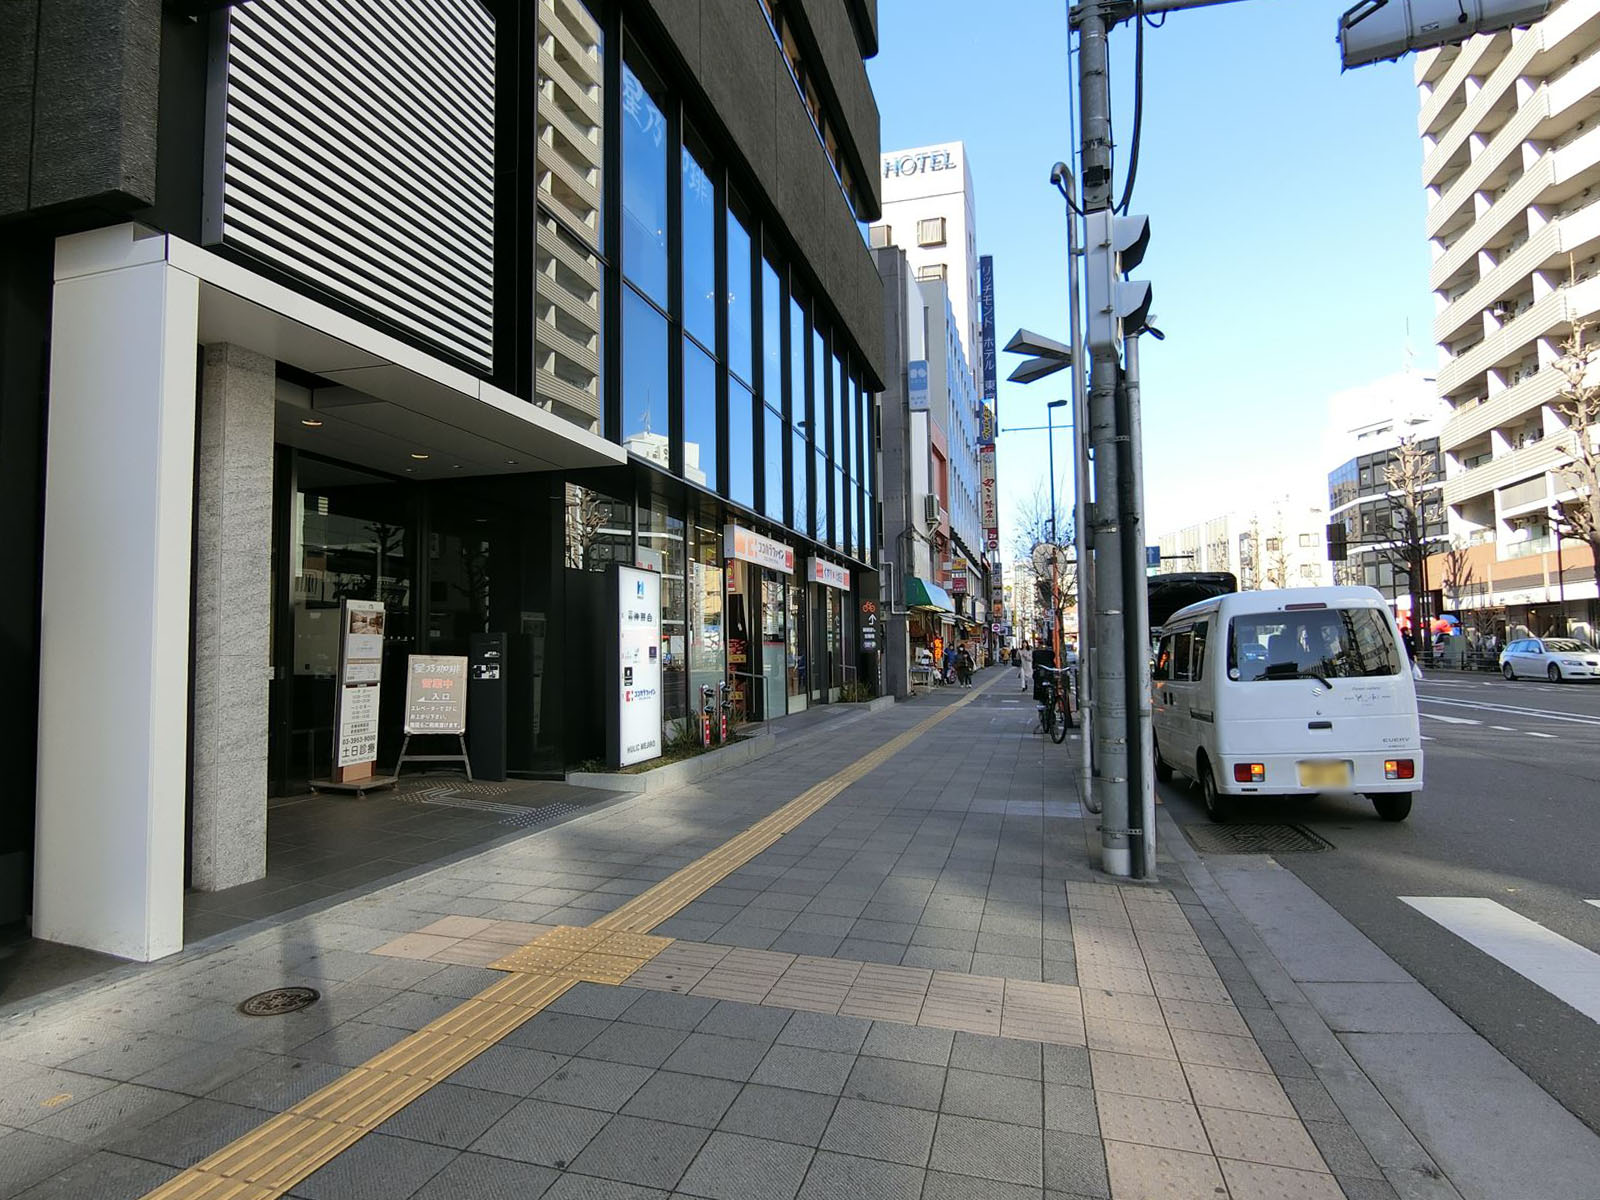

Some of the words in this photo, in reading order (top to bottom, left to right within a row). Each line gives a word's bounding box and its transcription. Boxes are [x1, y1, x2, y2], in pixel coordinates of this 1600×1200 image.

[884, 150, 957, 178] HOTEL
[983, 265, 992, 328] リッチモンド
[984, 337, 994, 370] ホテル
[432, 692, 450, 700] 入口
[342, 743, 375, 758] 土日診療
